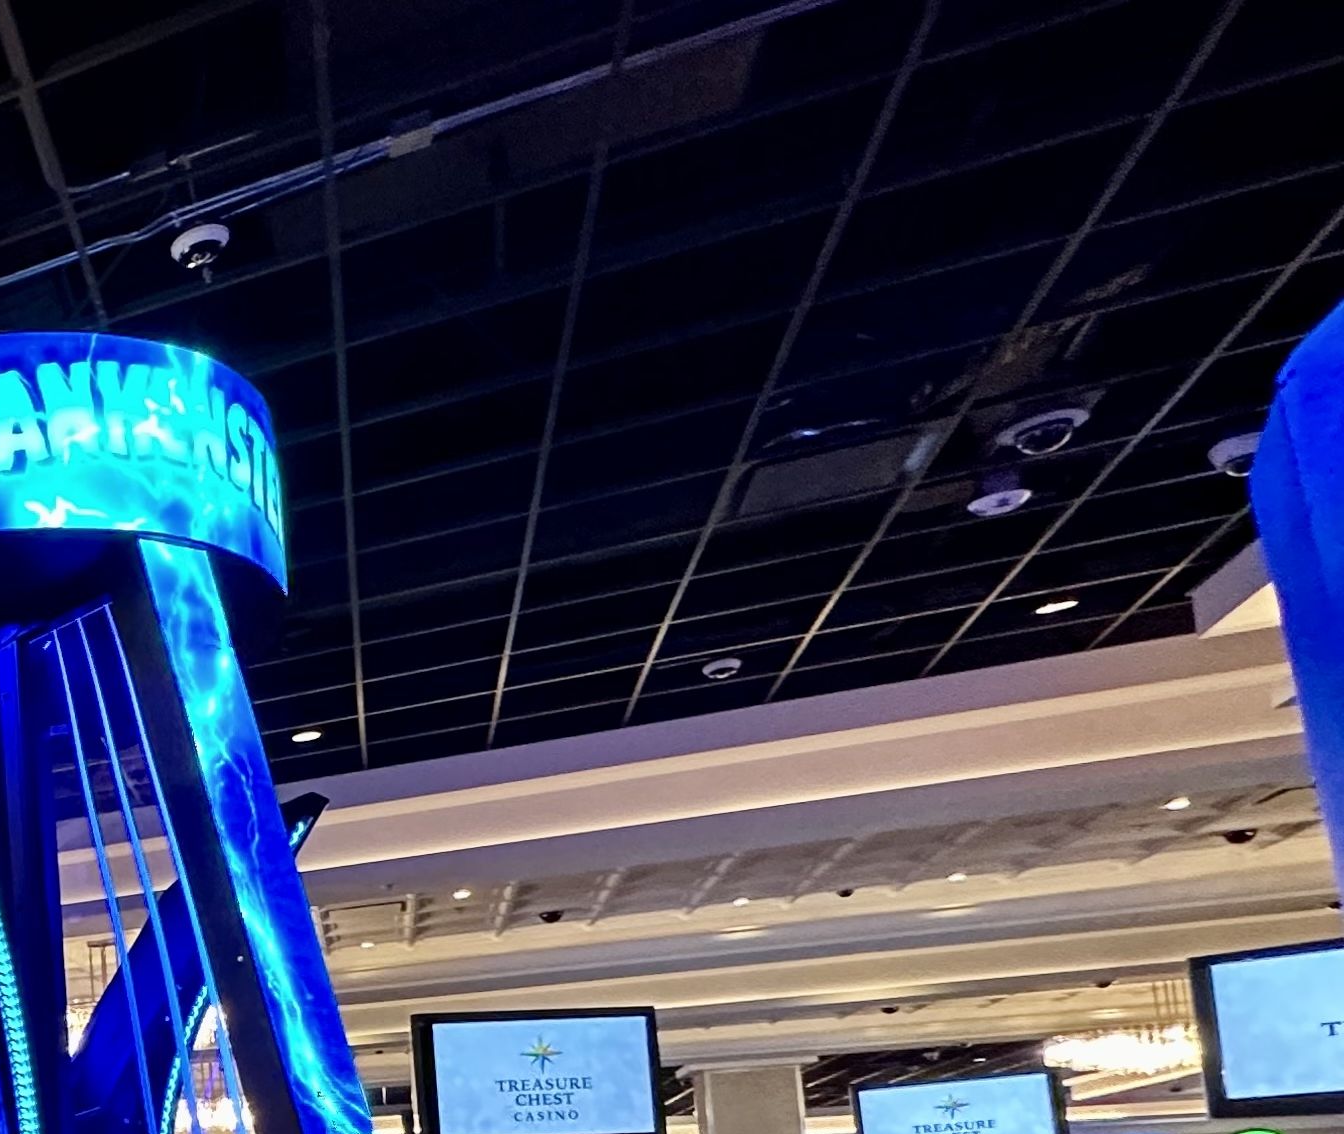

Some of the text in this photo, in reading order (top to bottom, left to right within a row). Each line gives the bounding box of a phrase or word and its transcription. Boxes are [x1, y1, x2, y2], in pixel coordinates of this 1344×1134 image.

[495, 1076, 593, 1093] TREASURE
[514, 1092, 575, 1108] CHEST
[512, 1110, 580, 1123] CASINO
[912, 1119, 997, 1134] TREASURE
